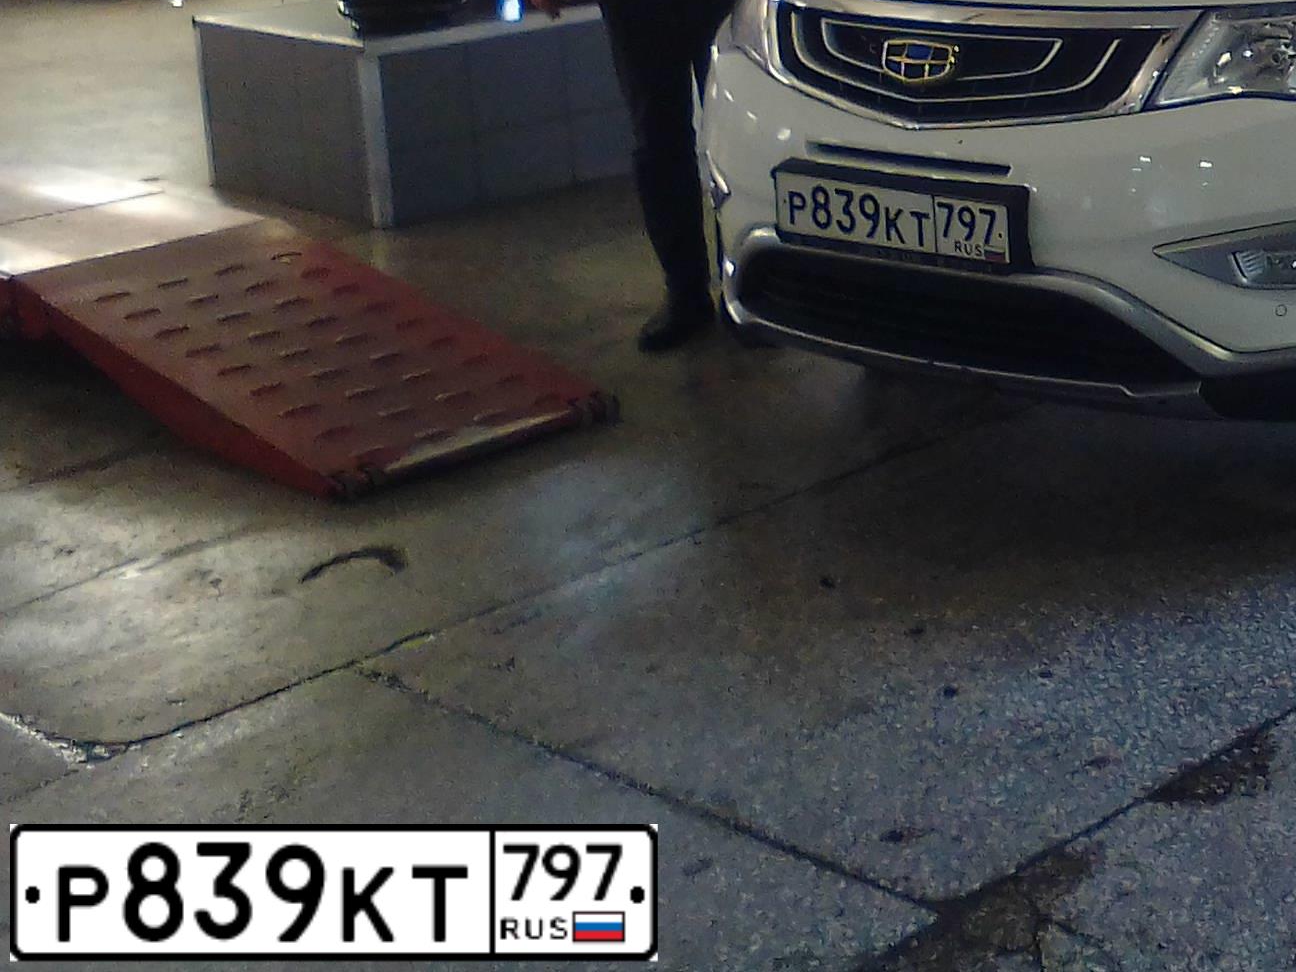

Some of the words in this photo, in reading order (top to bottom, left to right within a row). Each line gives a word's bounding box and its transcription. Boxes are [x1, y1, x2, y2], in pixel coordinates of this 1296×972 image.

[787, 183, 931, 248] Р839КТ
[937, 201, 996, 245] 797
[954, 239, 984, 258] RUS
